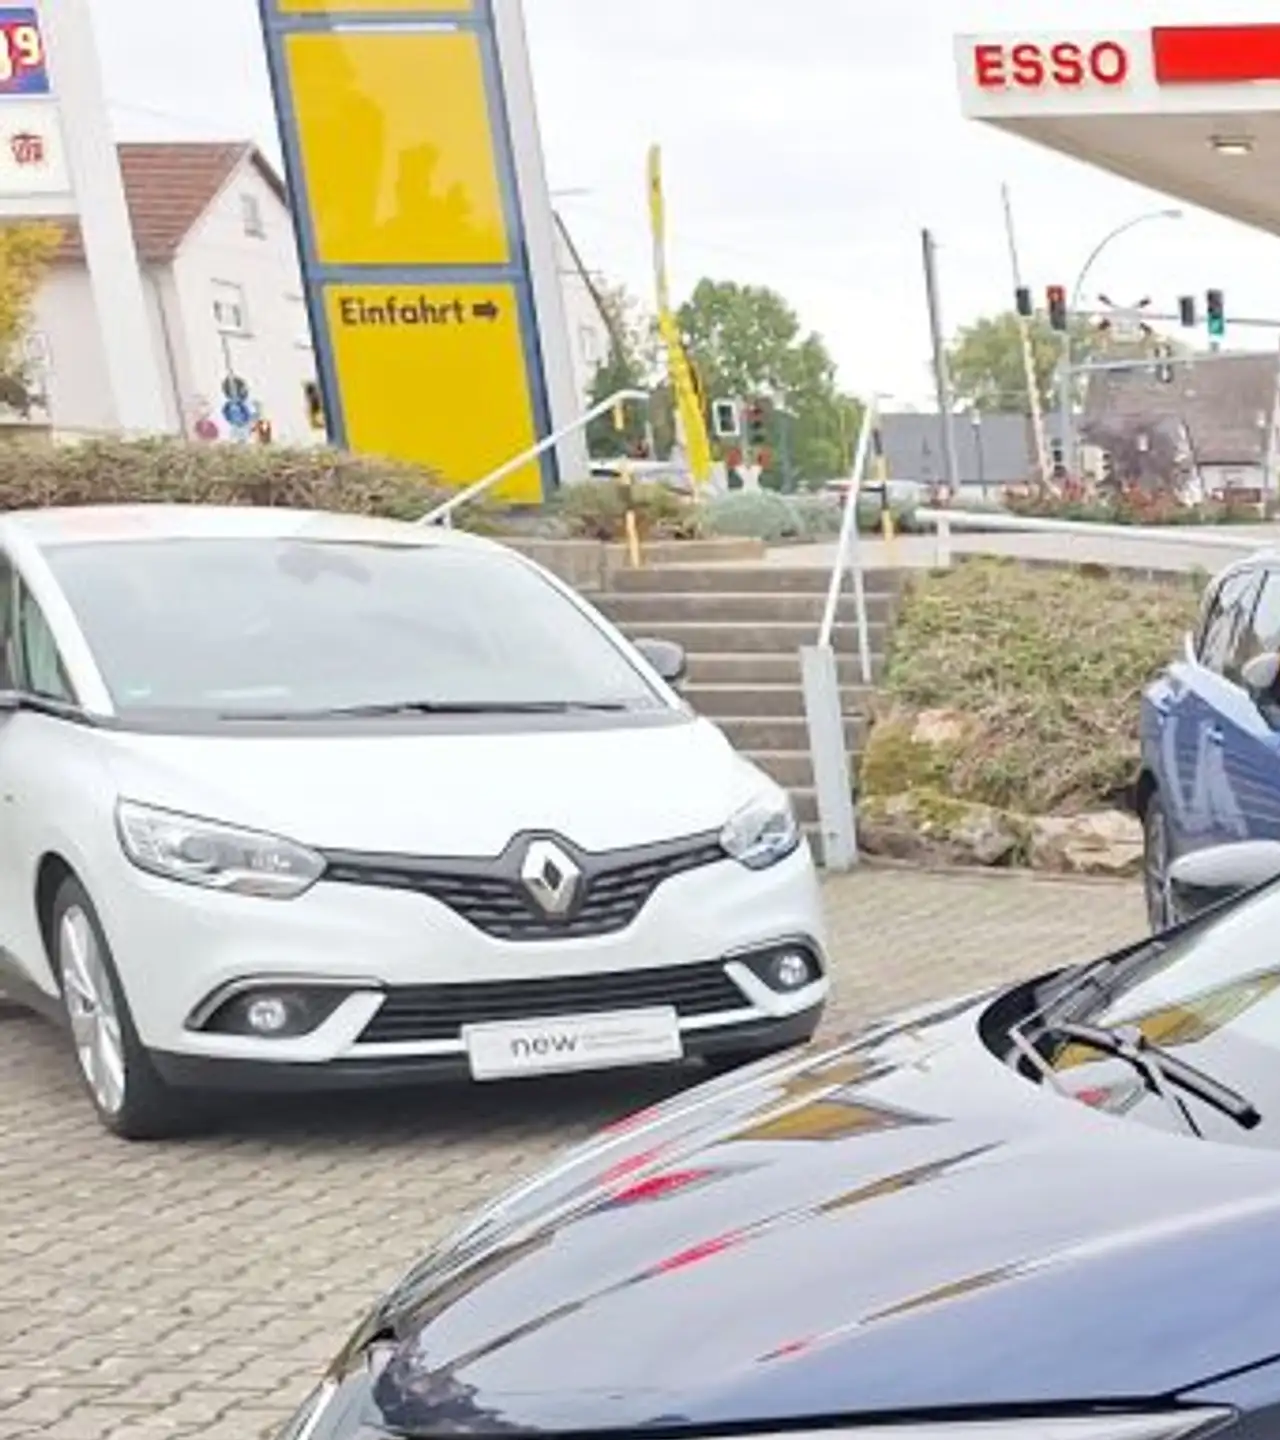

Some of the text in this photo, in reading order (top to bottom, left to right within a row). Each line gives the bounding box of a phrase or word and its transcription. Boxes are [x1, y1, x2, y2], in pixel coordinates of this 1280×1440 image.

[974, 41, 1127, 86] ESSO
[339, 294, 464, 325] Einfahrt
[510, 1032, 579, 1059] new
